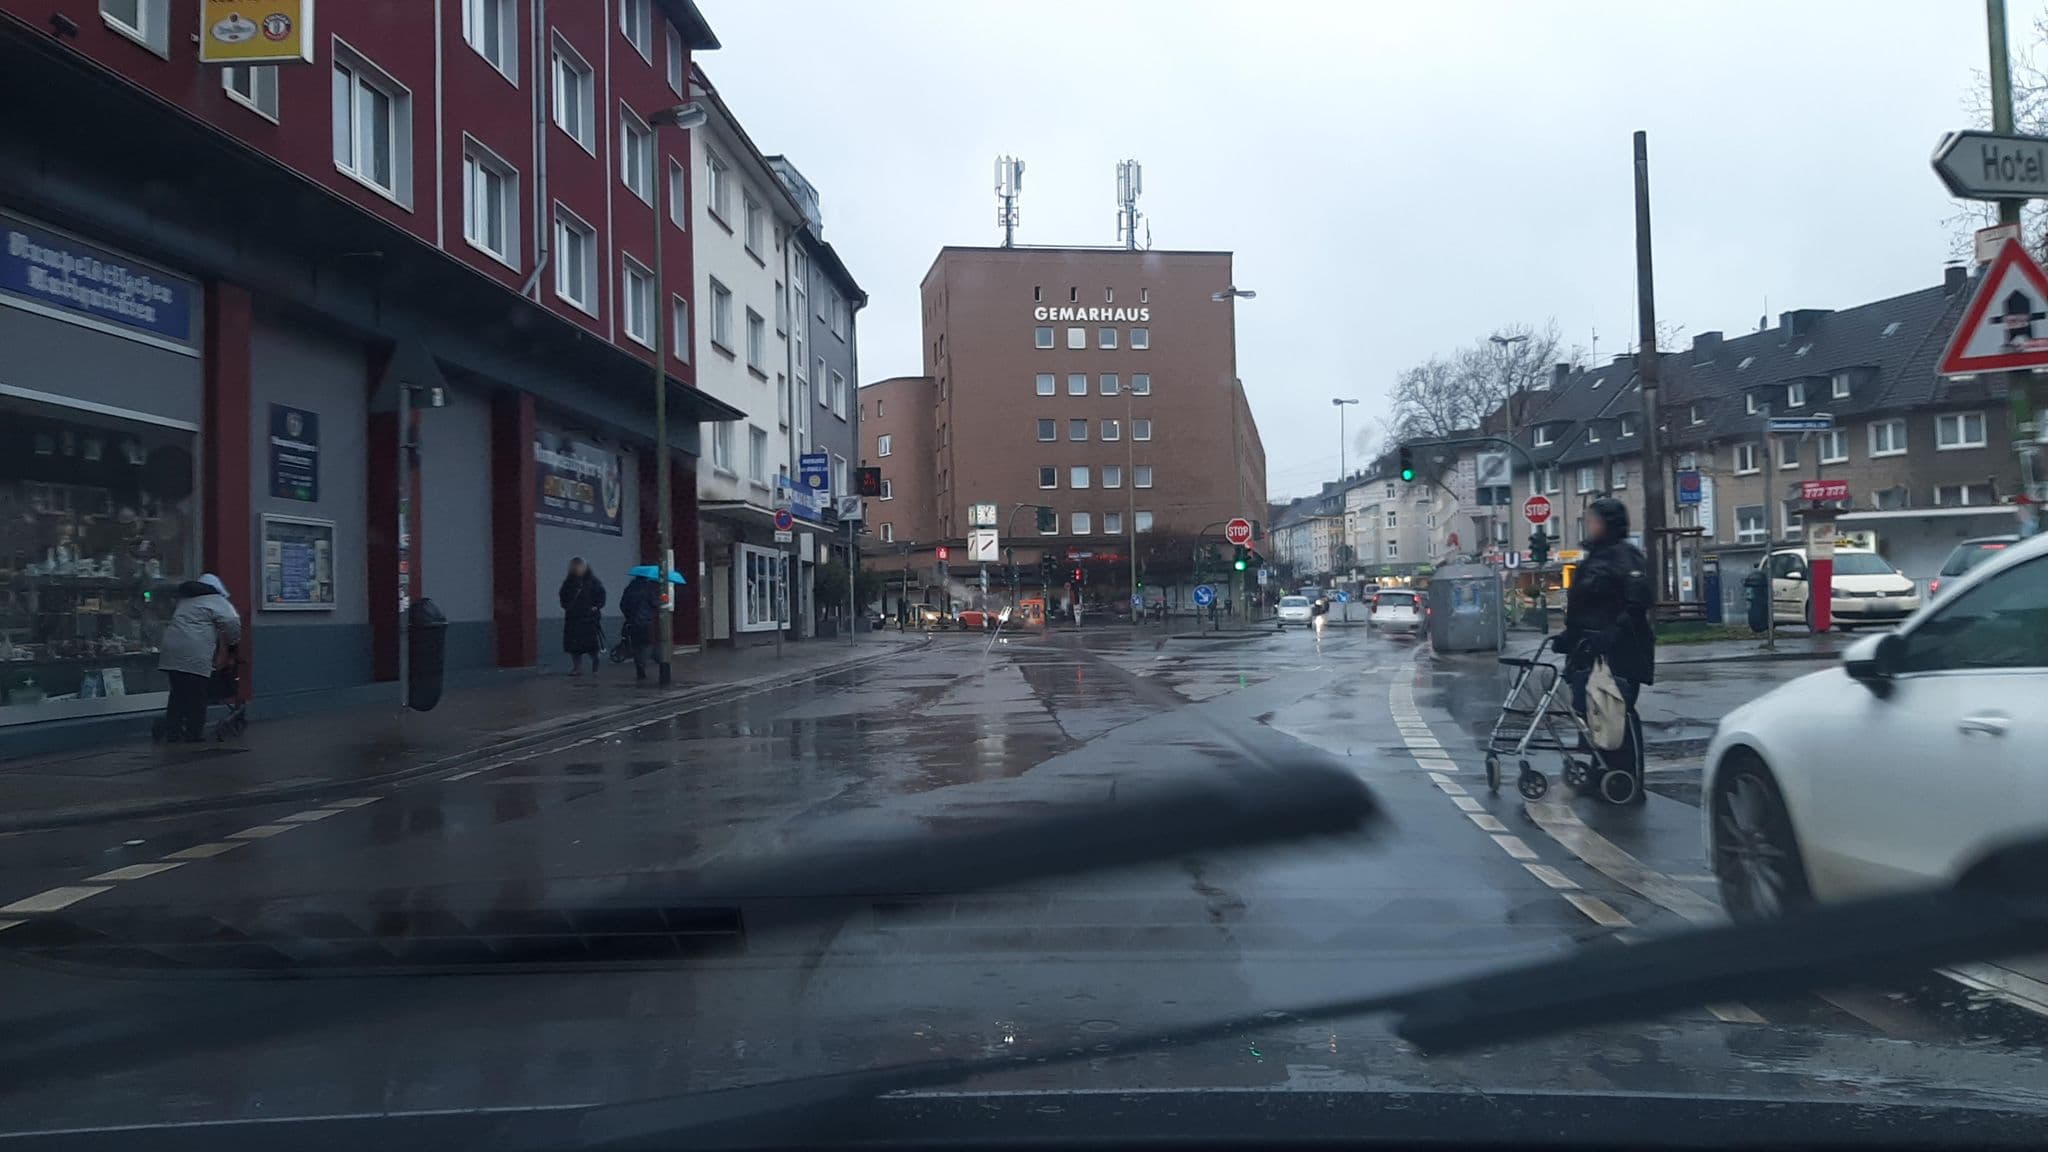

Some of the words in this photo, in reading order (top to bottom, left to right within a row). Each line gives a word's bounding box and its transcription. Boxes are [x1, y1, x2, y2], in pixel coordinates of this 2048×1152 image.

[1981, 144, 2044, 183] Hotel
[1034, 306, 1150, 322] GEMARHAUS
[1525, 503, 1550, 517] STOP
[1228, 526, 1249, 537] STOP
[1504, 551, 1520, 569] U
